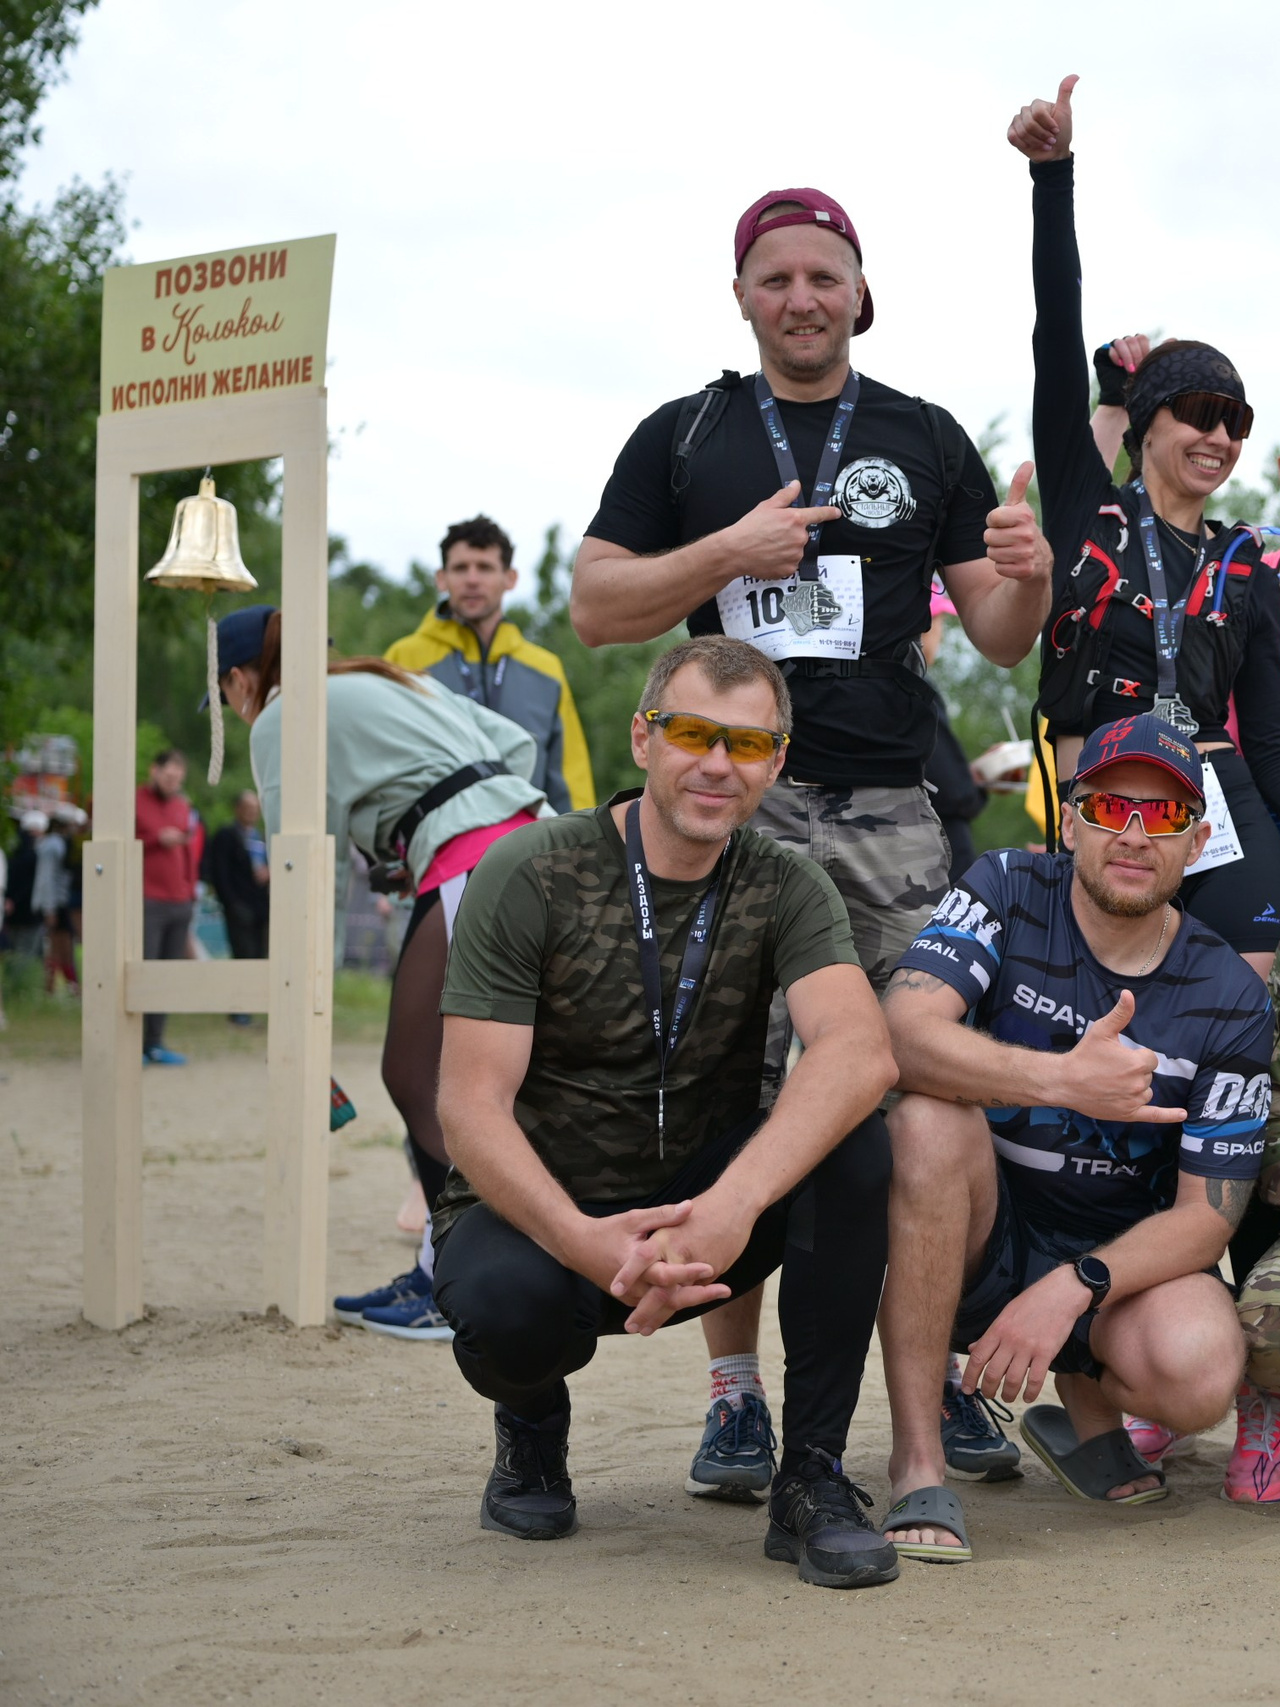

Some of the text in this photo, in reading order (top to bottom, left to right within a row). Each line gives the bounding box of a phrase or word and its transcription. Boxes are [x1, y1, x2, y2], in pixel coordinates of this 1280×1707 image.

[155, 248, 288, 299] ПОЗВОНИ
[162, 297, 285, 366] Колокол
[111, 355, 313, 412] ИСПОЛНИ ЖЕЛАНИЕ
[634, 863, 653, 940] РАЗДОРЫ
[653, 1009, 661, 1037] 2025
